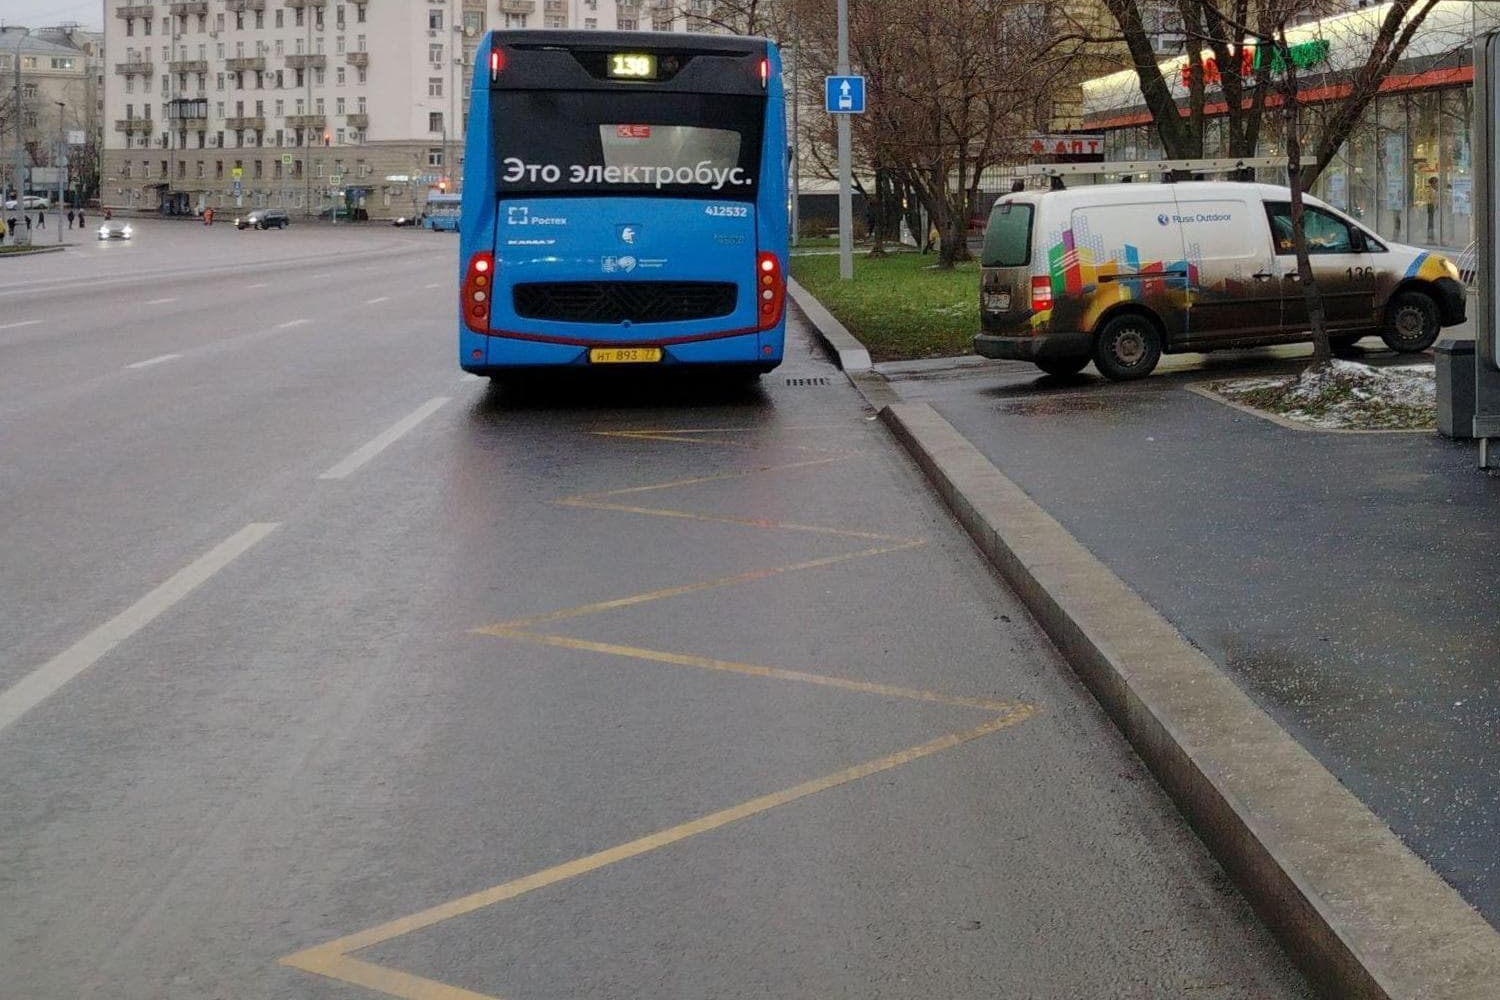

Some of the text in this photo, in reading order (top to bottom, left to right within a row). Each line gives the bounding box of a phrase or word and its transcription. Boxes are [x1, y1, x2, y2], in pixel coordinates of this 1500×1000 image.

[502, 157, 752, 190] Это электробус.
[704, 205, 748, 218] 412532
[532, 216, 567, 225] Ростех
[1172, 214, 1231, 223] Russ Outdoor
[616, 350, 638, 361] 893
